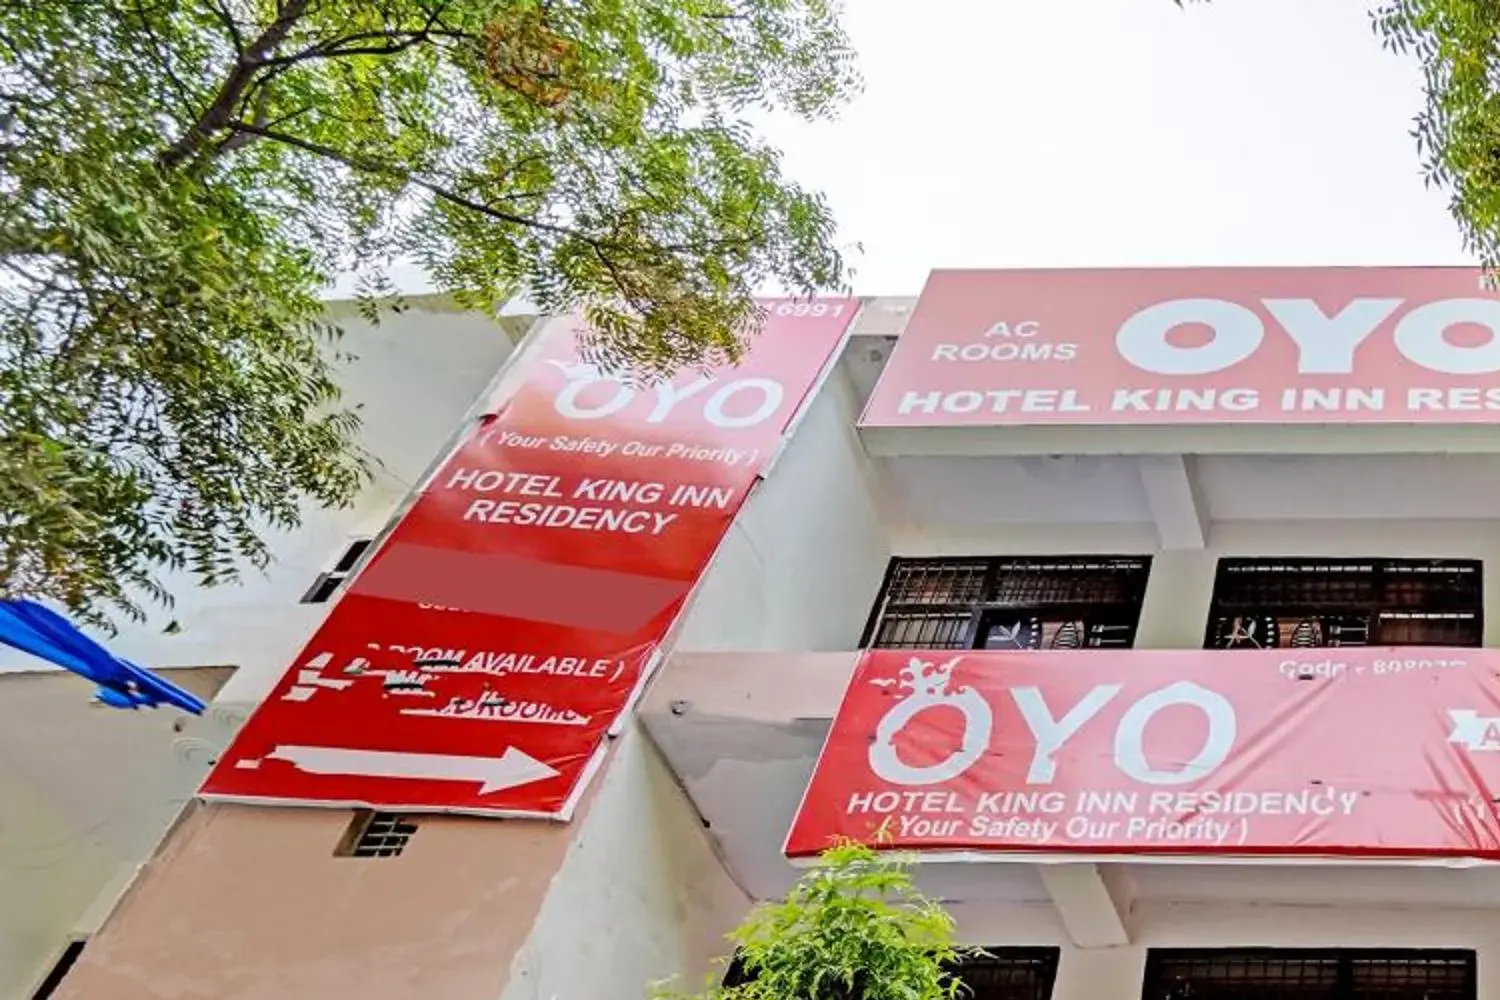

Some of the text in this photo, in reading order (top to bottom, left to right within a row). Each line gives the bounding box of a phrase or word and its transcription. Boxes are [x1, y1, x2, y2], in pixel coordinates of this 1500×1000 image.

[984, 321, 1040, 338] AC
[931, 343, 1080, 362] ROOMS
[553, 368, 784, 428] OYO
[897, 389, 1091, 414] HOTEL
[1110, 388, 1260, 412] KING
[1282, 387, 1386, 411] INN
[497, 430, 546, 451] Your
[548, 435, 616, 460] Safety
[621, 440, 661, 458] Our
[662, 445, 748, 467] Priority
[446, 468, 734, 509] HOTEL KING INN
[464, 500, 677, 534] RESIDENCY
[466, 652, 609, 678] AVAILABLE
[868, 680, 1238, 786] OYO
[847, 788, 1358, 816] HOTEL KING INN RESIDENCY
[898, 815, 964, 838] Your
[968, 815, 1056, 843] Safety
[1061, 817, 1120, 839] Our
[1124, 816, 1233, 844] Priority
